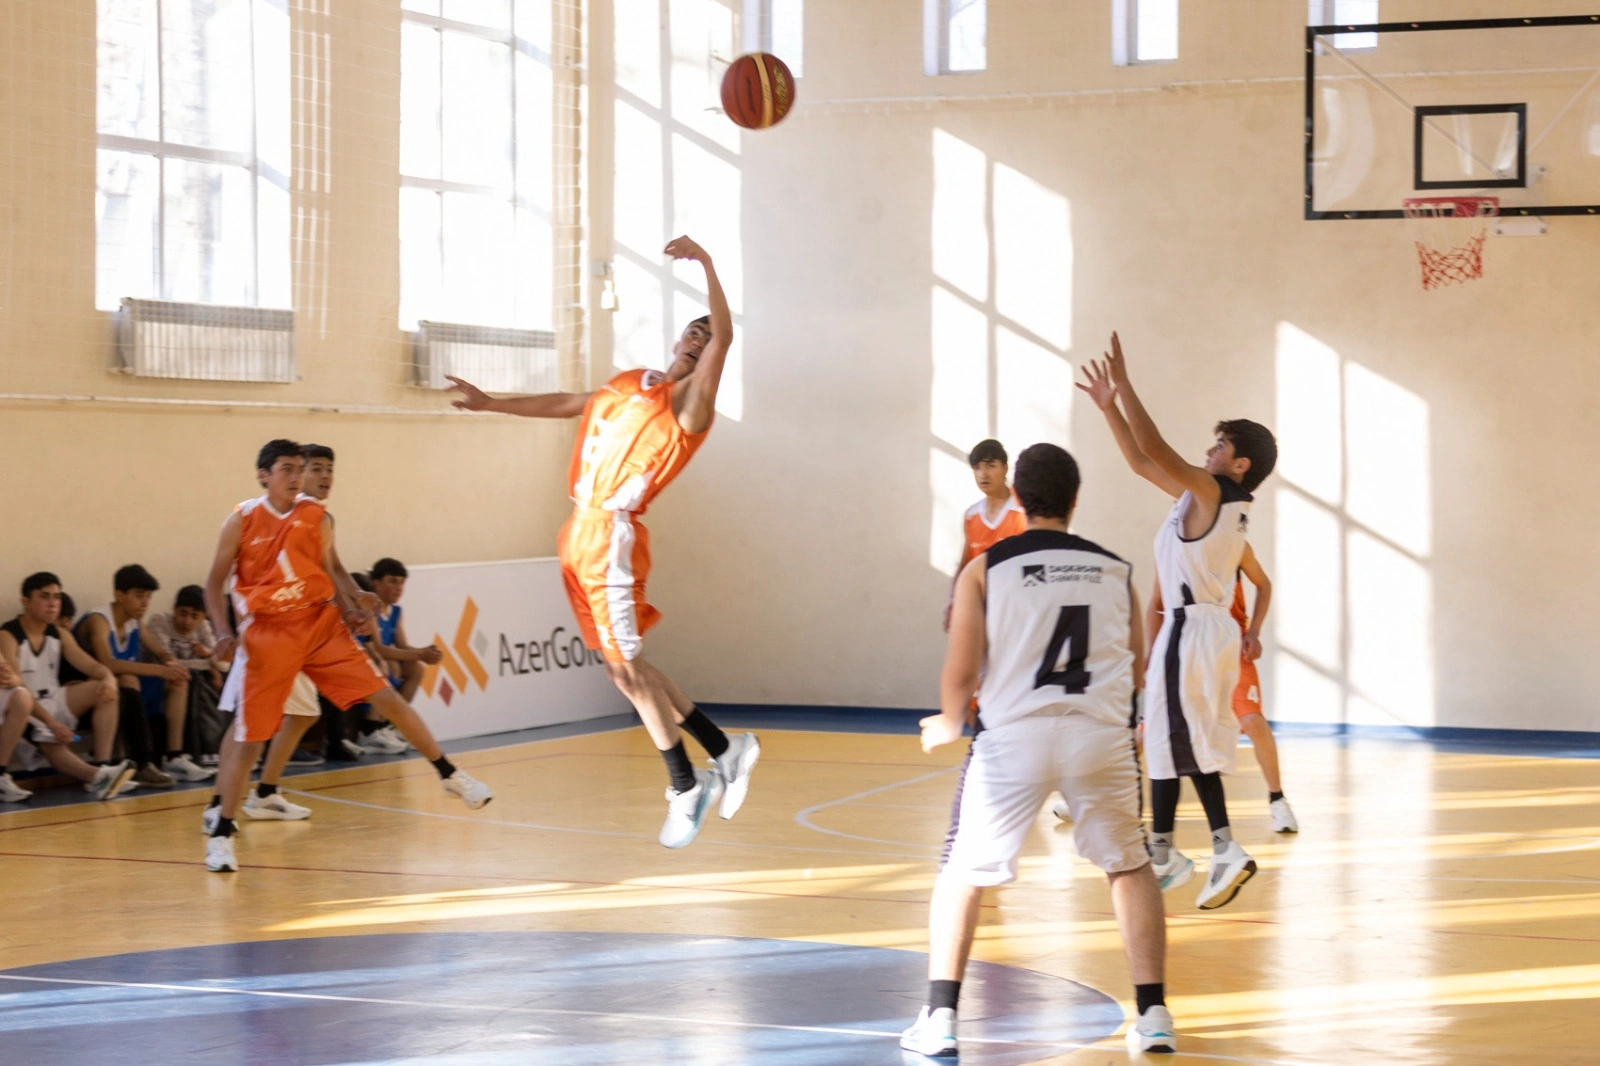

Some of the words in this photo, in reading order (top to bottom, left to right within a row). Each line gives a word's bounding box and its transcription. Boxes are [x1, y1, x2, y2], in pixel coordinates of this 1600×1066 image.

[500, 626, 604, 676] AzerGo
[1033, 605, 1092, 694] 4
[1246, 685, 1260, 704] 4
